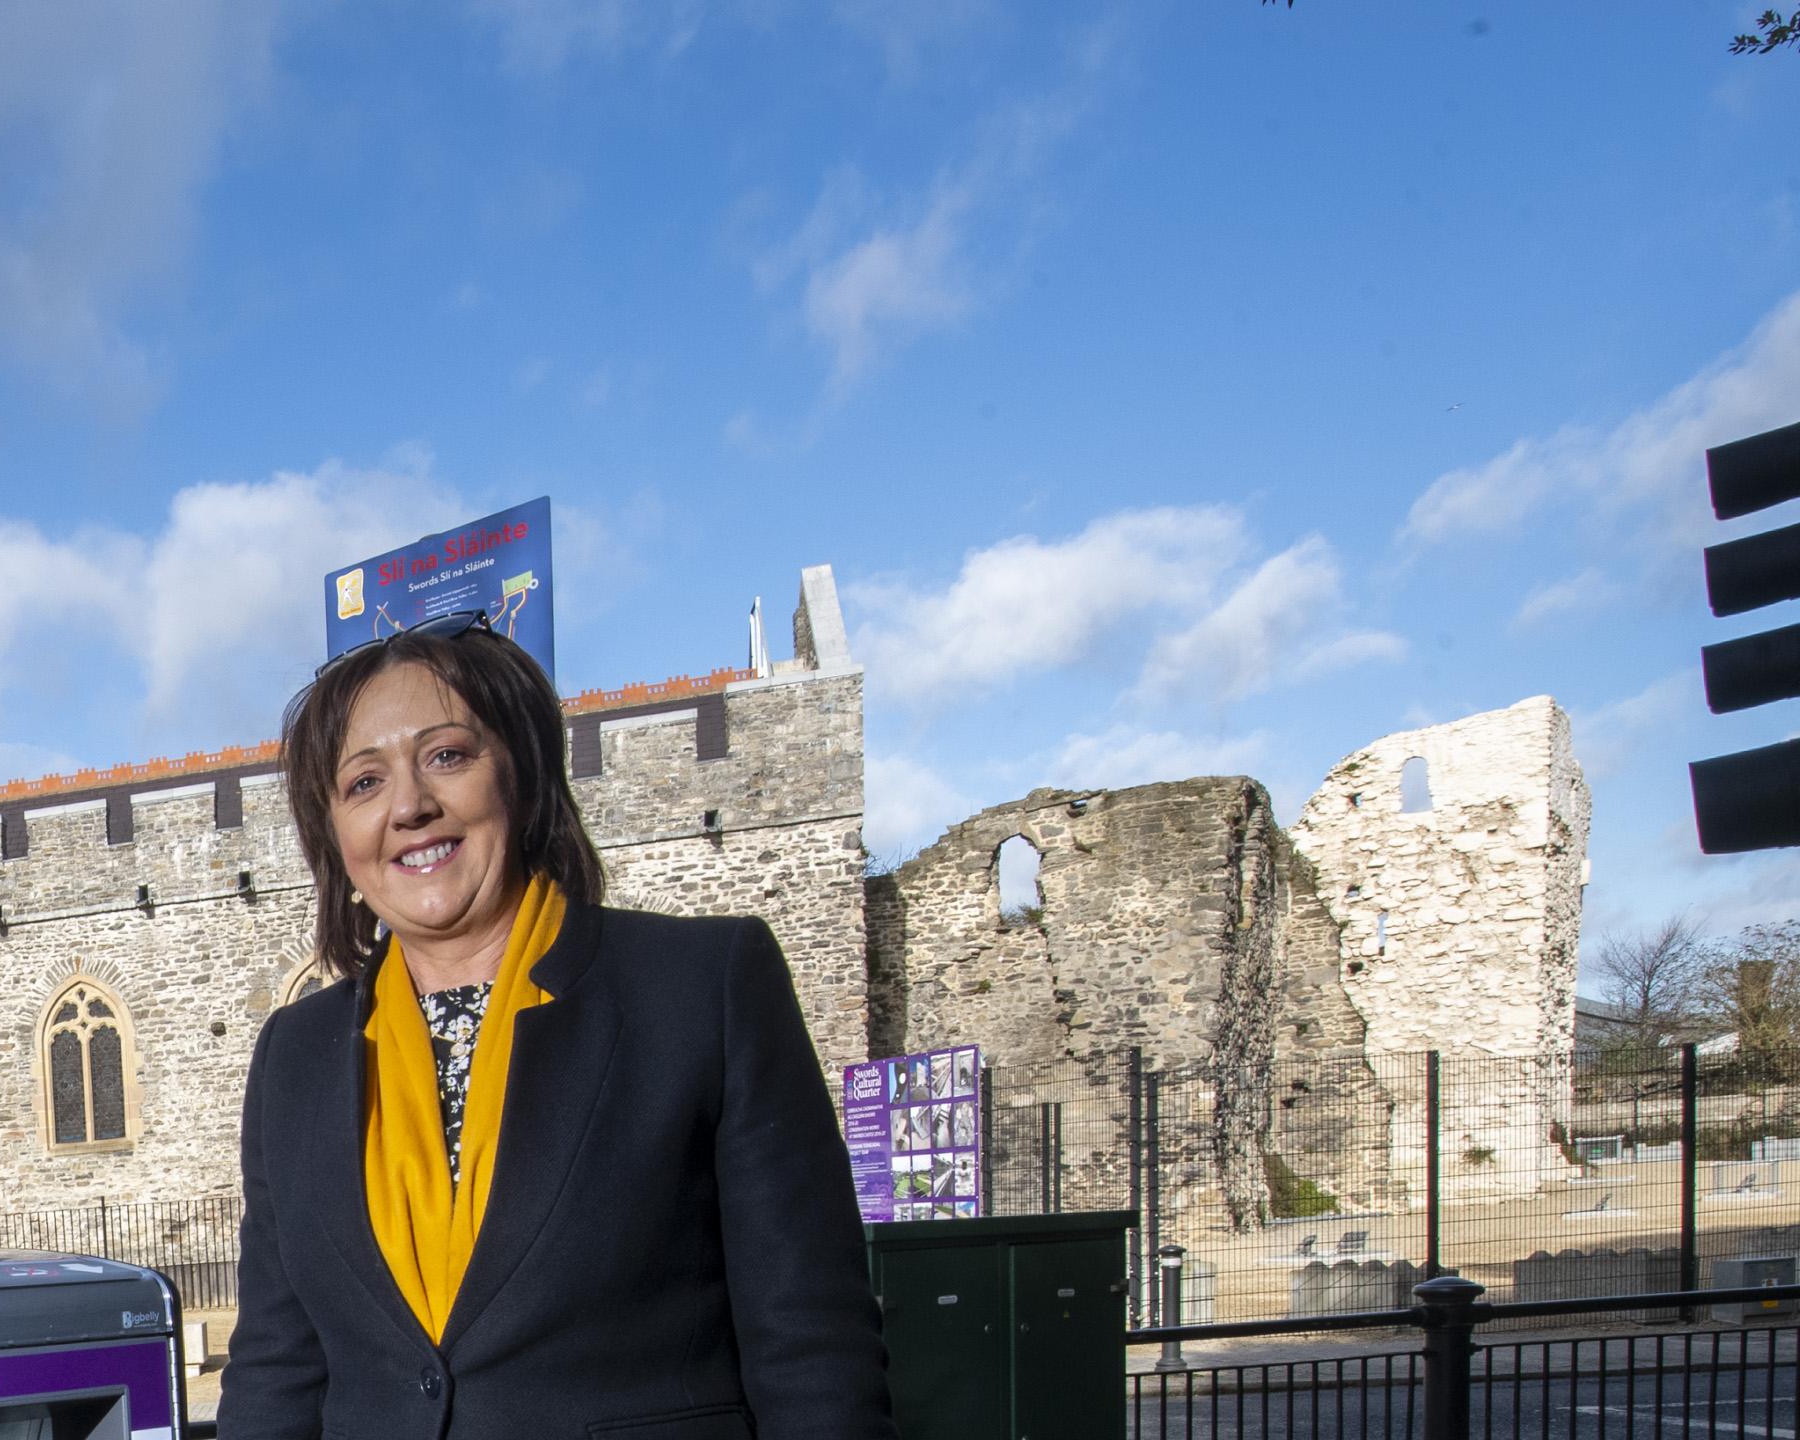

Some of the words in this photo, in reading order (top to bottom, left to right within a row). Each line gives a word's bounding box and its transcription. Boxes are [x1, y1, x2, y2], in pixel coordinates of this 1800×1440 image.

[378, 555, 406, 586] Slí
[411, 553, 438, 575] na
[444, 521, 529, 563] Sláinte
[408, 576, 439, 593] Swords
[452, 569, 463, 578] na
[464, 557, 495, 574] Sláinte
[854, 1066, 880, 1078] Swords
[853, 1075, 882, 1089] Cultural
[854, 1087, 881, 1101] Quarter
[122, 1311, 160, 1329] Bigbelly
